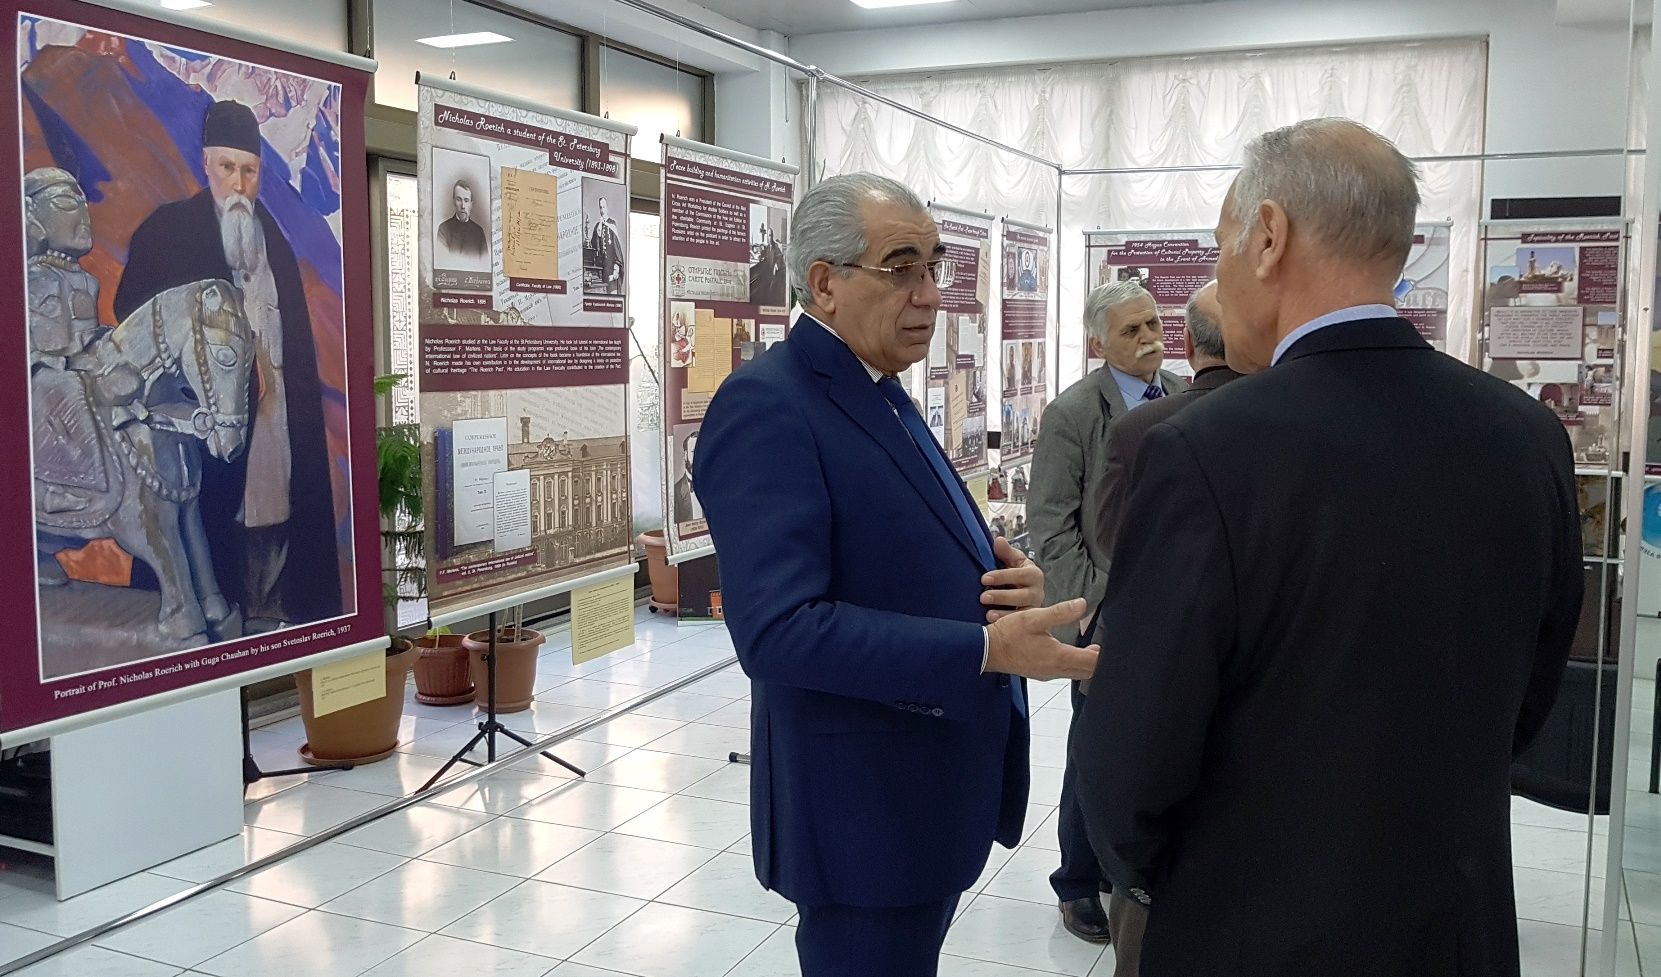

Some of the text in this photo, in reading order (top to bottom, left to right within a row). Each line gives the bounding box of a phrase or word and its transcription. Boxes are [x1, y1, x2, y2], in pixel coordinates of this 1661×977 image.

[438, 110, 473, 126] Nicholas
[475, 117, 505, 133] Roerich
[513, 128, 537, 140] student
[538, 133, 545, 145] of
[546, 134, 556, 144] the
[569, 138, 600, 158] Petersburg
[554, 151, 585, 170] University
[54, 624, 351, 700] Portrait of Prof. Nicholas Roerich with Guga Chauhan by his son Svetoslav Roerich, 1937
